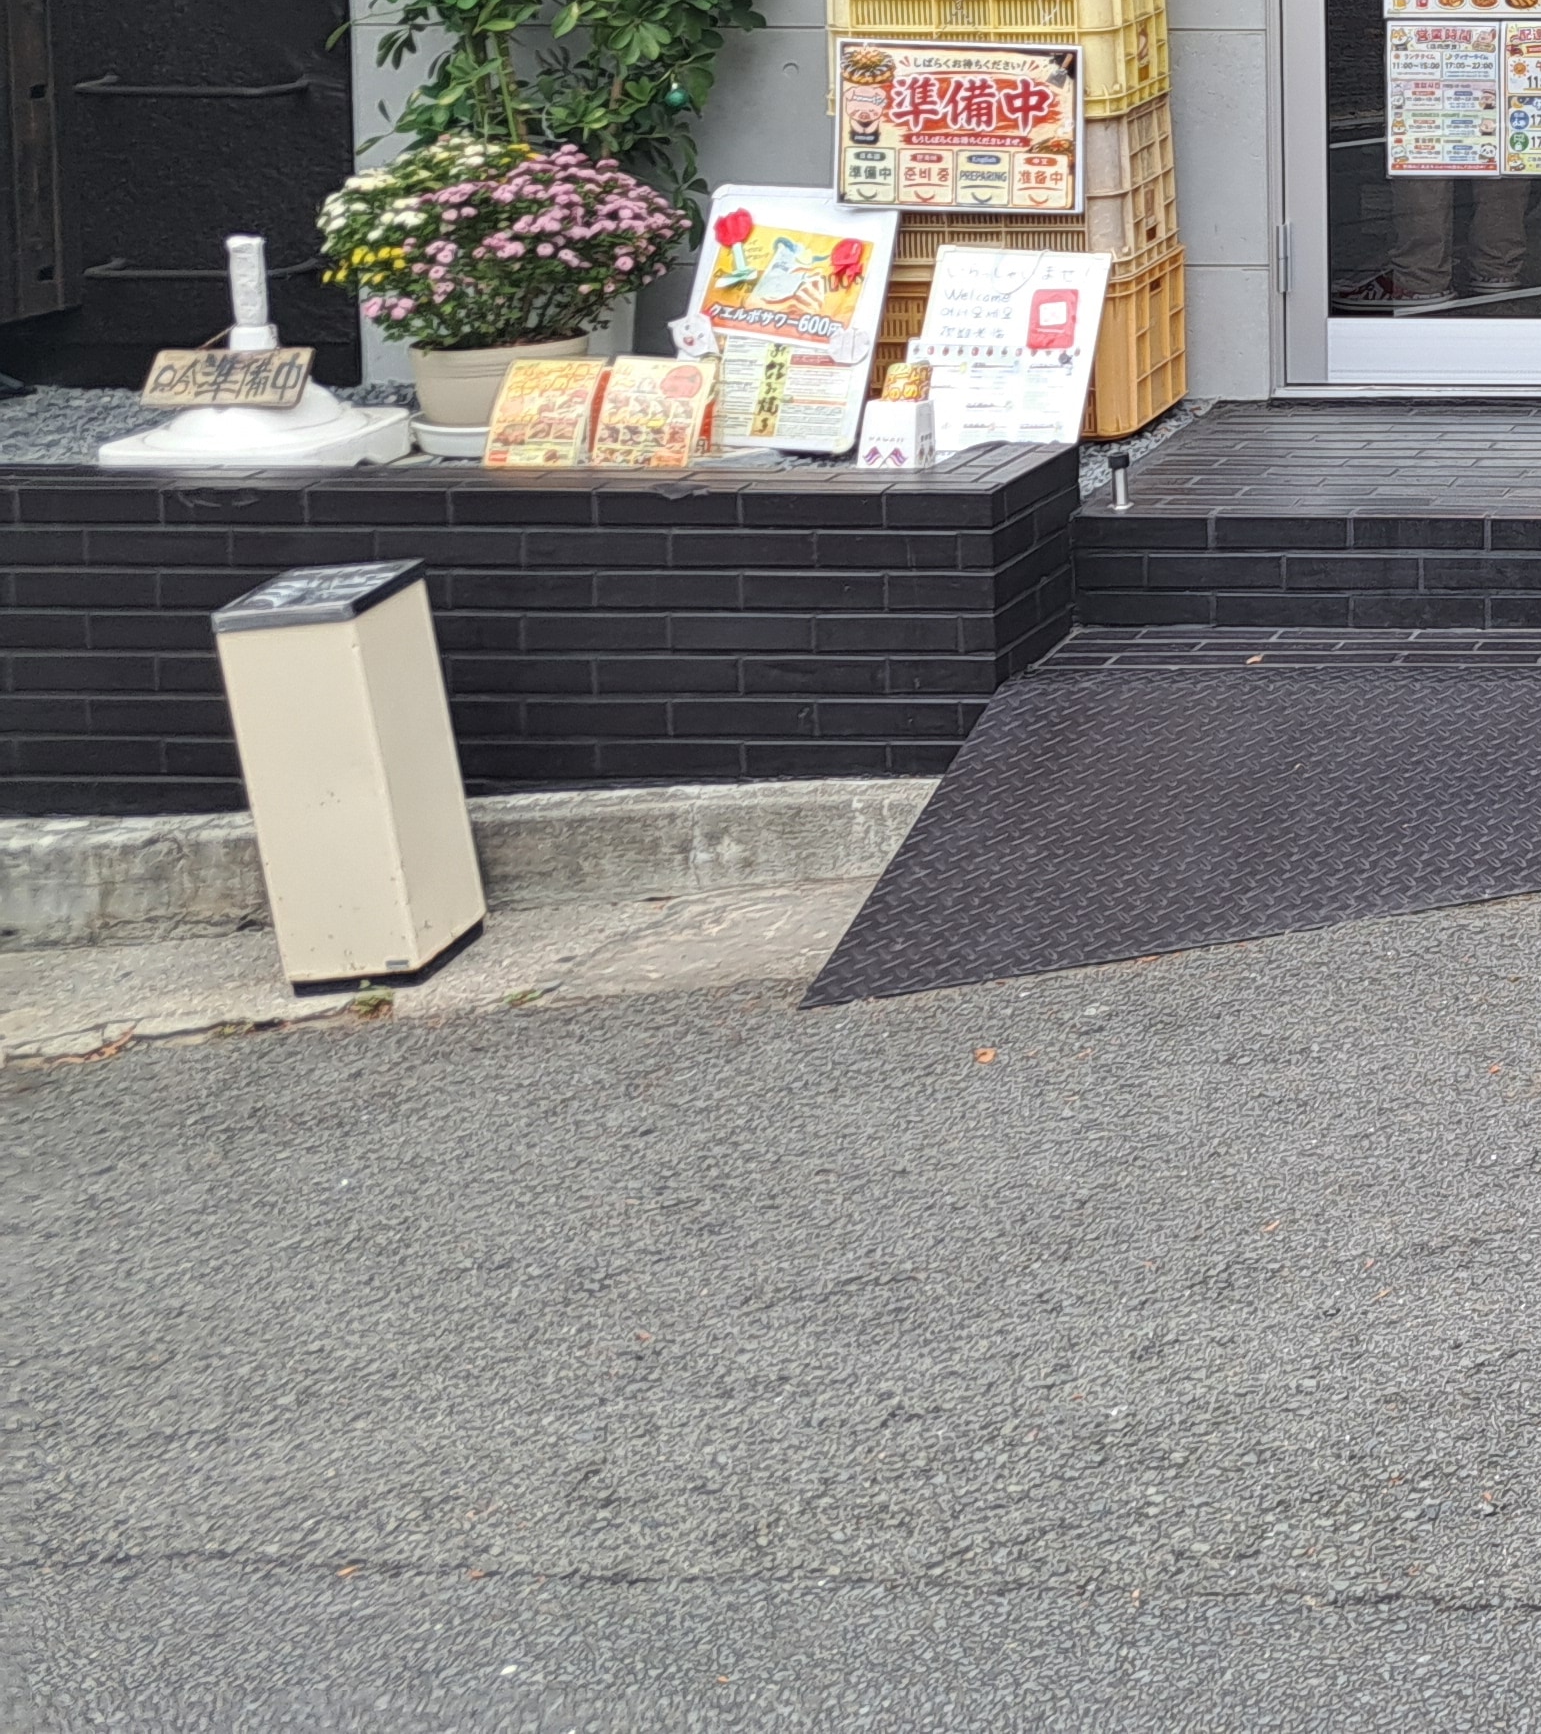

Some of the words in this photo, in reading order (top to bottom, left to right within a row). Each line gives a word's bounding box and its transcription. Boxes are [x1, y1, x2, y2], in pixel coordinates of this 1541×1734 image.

[891, 76, 1052, 134] 準備中
[849, 165, 892, 181] 準備中
[904, 167, 932, 182] 준비
[937, 167, 950, 182] 중
[959, 170, 1008, 183] PREPARING
[1018, 170, 1063, 186] 准备中
[945, 289, 1012, 303] Welcome
